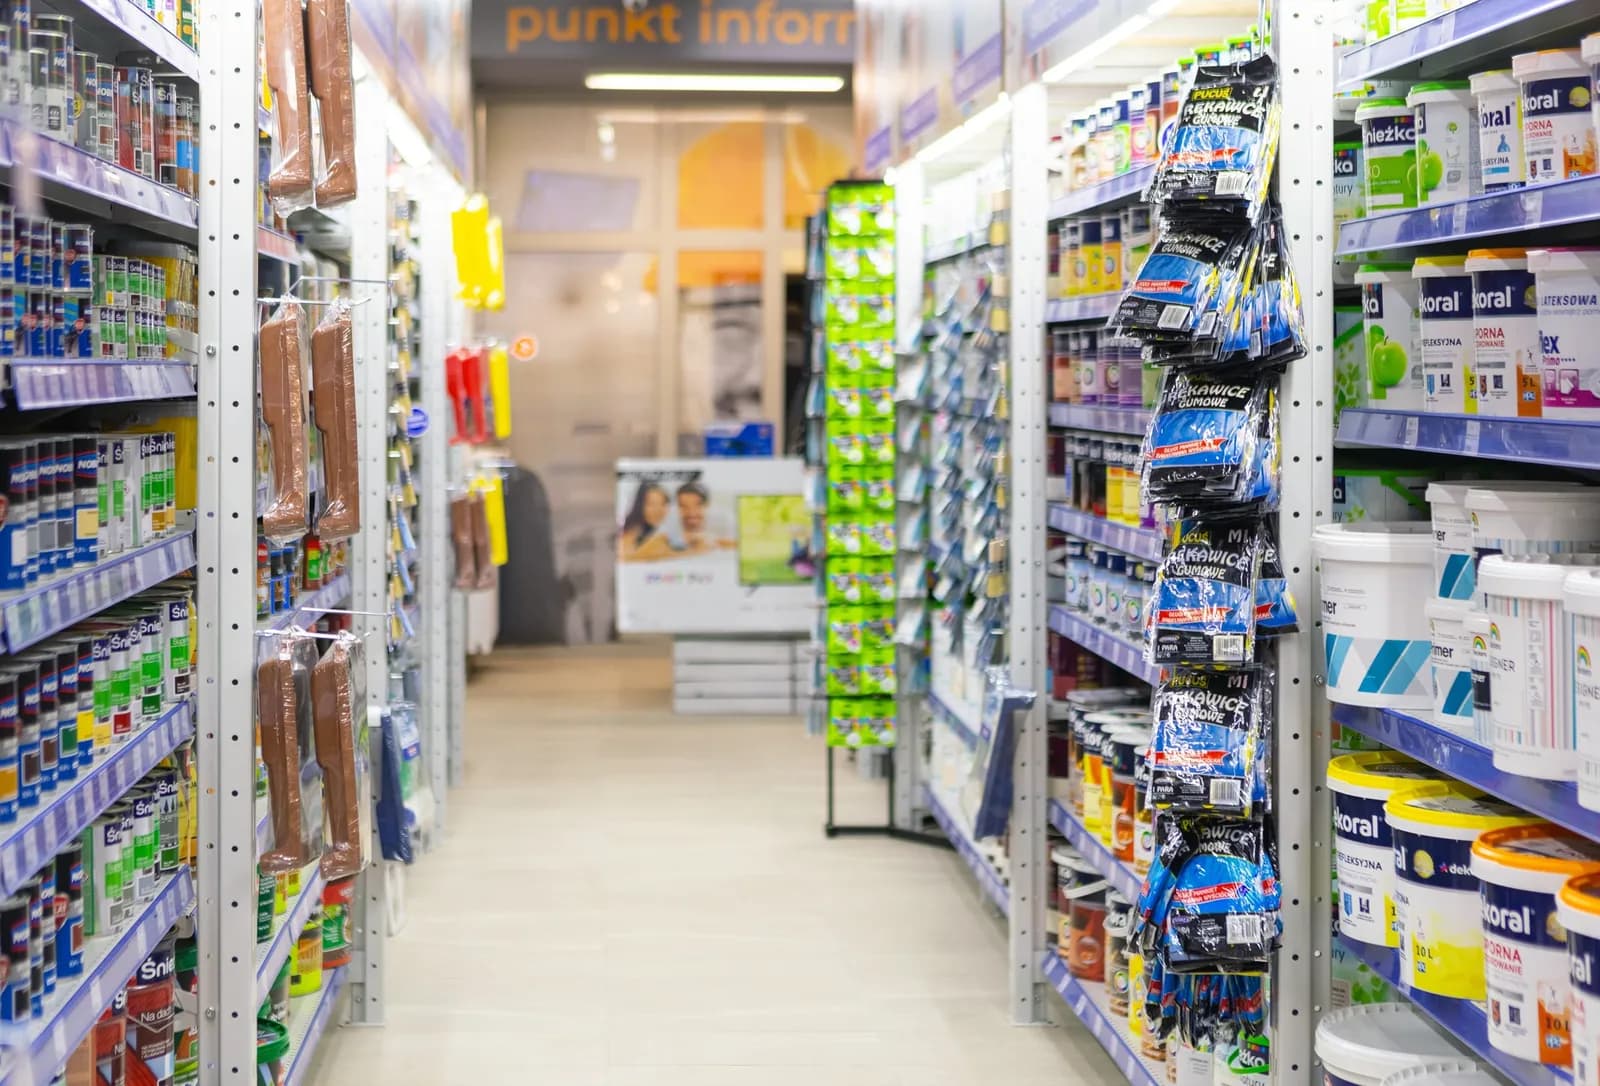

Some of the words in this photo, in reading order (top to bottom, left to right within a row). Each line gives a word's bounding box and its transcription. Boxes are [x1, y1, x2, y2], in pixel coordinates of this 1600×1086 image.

[505, 0, 682, 54] punkt
[1193, 88, 1231, 100] PUCUS
[1480, 105, 1512, 129] oral
[1178, 397, 1229, 409] GUMOWE
